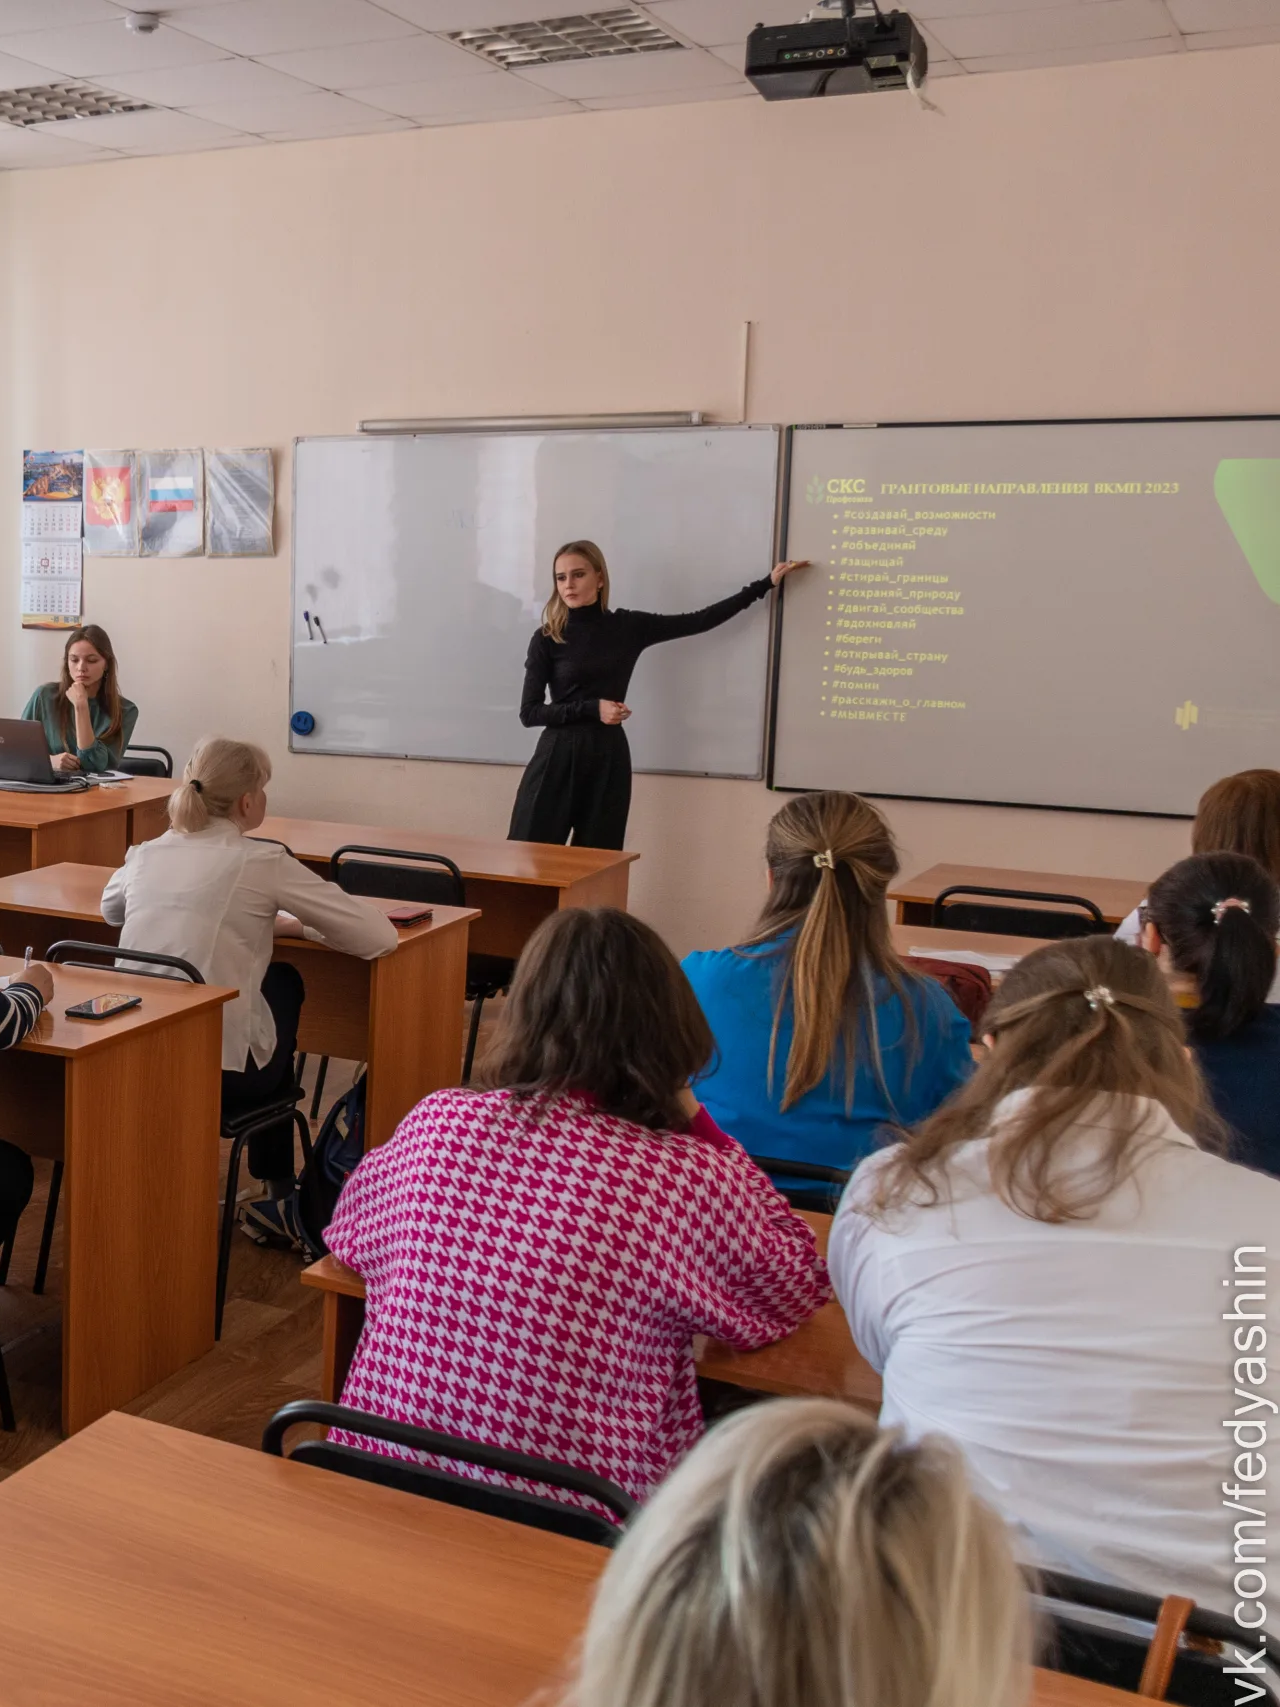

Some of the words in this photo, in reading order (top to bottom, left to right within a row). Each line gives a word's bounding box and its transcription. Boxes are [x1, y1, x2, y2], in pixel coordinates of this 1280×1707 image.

[826, 478, 866, 494] СКС
[880, 483, 972, 495] ГРАНТОВЫЕ
[974, 482, 1089, 495] НАПРАВЛЕНИЯ
[1094, 482, 1142, 495] ВКМП
[1144, 482, 1180, 495] 2023
[843, 509, 997, 521] #создавай_возможности
[841, 525, 949, 538] #развивай_среду
[841, 541, 917, 551] #объединяй
[840, 557, 904, 568] #защищай
[838, 572, 949, 584] #стирай_границы
[837, 587, 962, 601] #сохраняй_природу
[836, 603, 965, 616] #двигай_сообщества
[835, 618, 917, 630] #вдохновляй
[835, 633, 883, 646] #береги
[833, 649, 949, 664] #открывай_страну
[833, 664, 914, 677] #будь_здоров
[832, 680, 880, 690] #помни
[831, 695, 967, 710] #расскажи_о_главном
[829, 709, 908, 722] #МЫВМЕСТЕ
